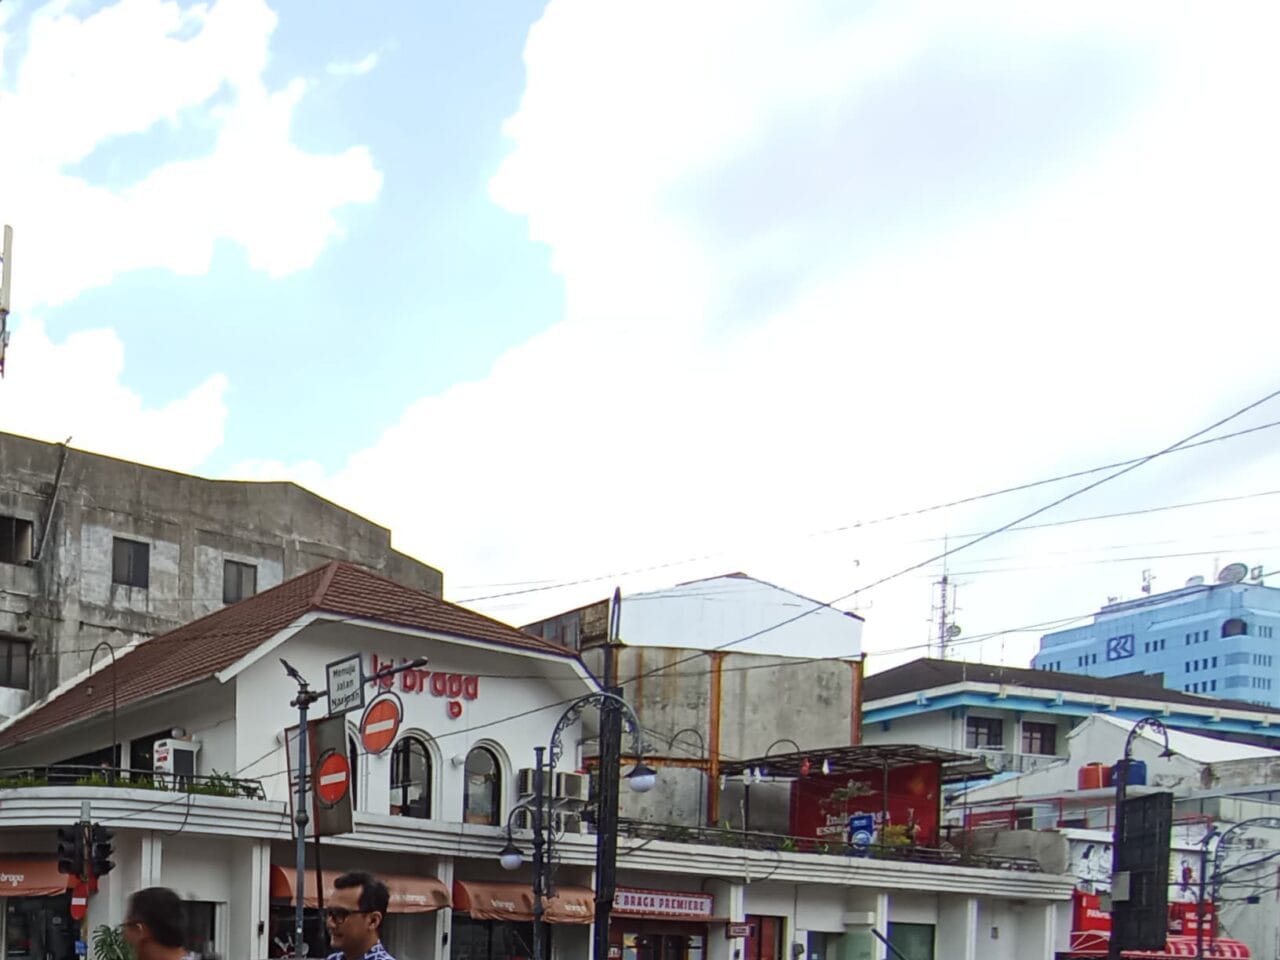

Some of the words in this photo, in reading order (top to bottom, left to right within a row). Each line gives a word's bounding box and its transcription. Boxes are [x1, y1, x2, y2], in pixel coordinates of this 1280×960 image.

[372, 654, 394, 689] le
[401, 658, 480, 719] braga
[624, 895, 655, 908] BRAGA
[659, 898, 705, 912] PREMIERE
